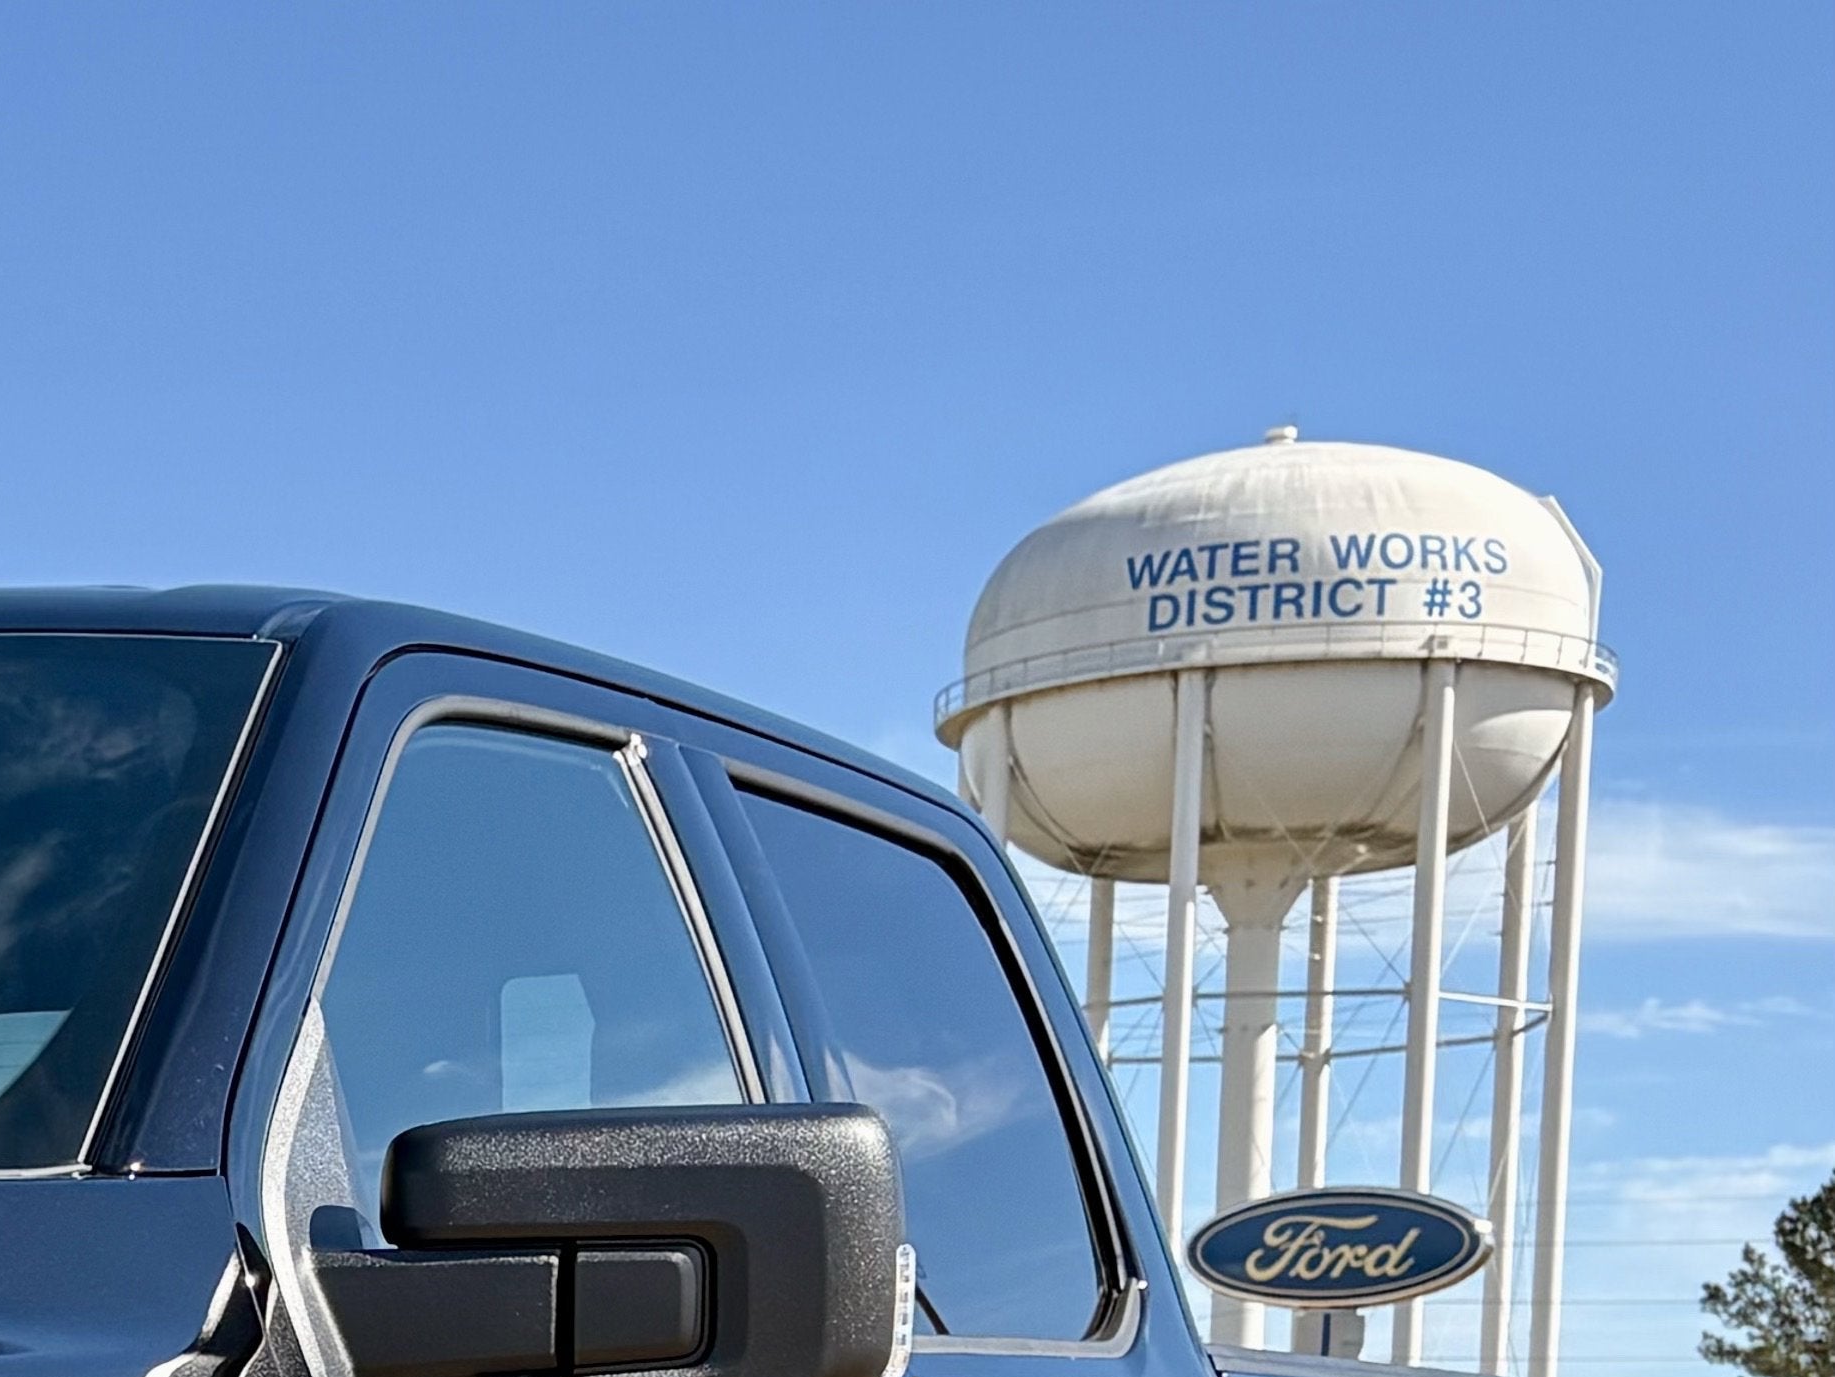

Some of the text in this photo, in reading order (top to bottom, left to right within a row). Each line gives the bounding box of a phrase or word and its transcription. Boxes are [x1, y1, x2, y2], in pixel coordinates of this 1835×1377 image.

[1127, 532, 1509, 591] WATER WORKS
[1147, 577, 1484, 632] DISTRICT #3
[1245, 1214, 1421, 1282] Ford
